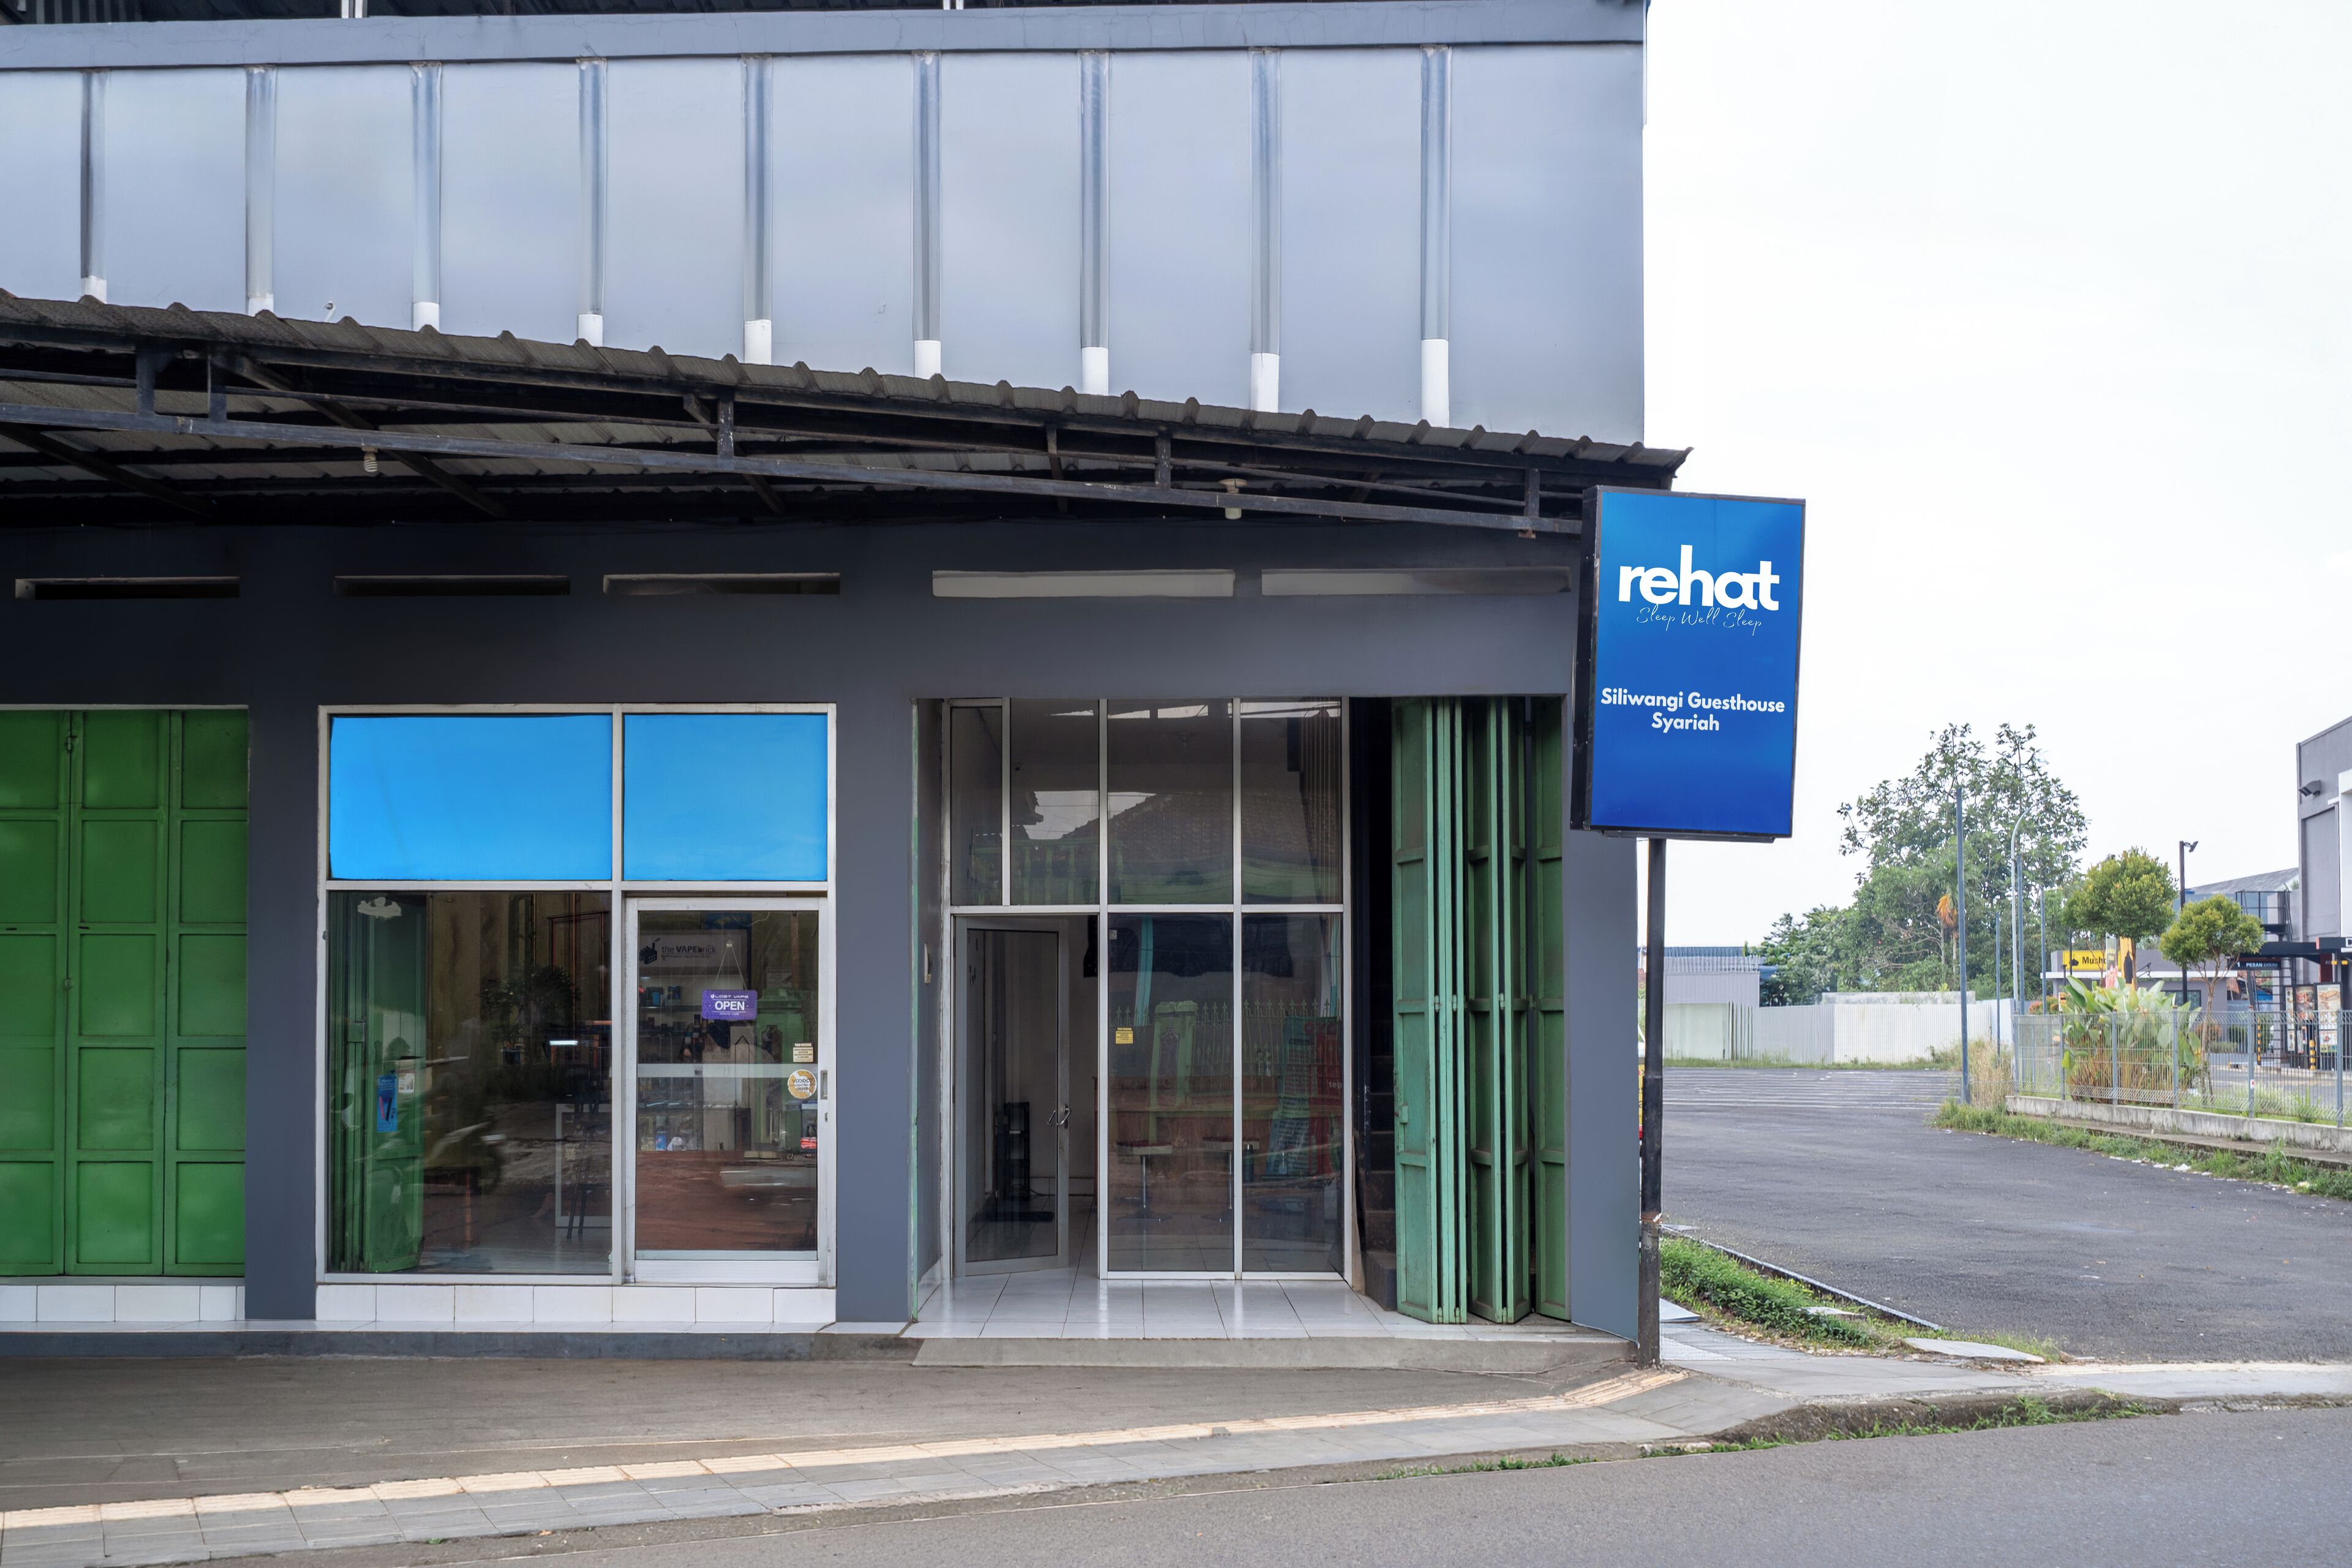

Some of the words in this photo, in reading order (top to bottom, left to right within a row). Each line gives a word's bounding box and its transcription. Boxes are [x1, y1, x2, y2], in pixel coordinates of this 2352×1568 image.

[1618, 544, 1780, 611] rehat
[1637, 603, 1675, 631] Sleep
[1681, 607, 1720, 625] Well
[1723, 608, 1762, 636] Sleep
[1600, 687, 1684, 712] Siliwangi
[1687, 692, 1785, 713] Guesthouse
[1651, 712, 1720, 734] Syariah
[676, 944, 716, 953] VAPEbrick
[714, 1000, 745, 1011] OPEN
